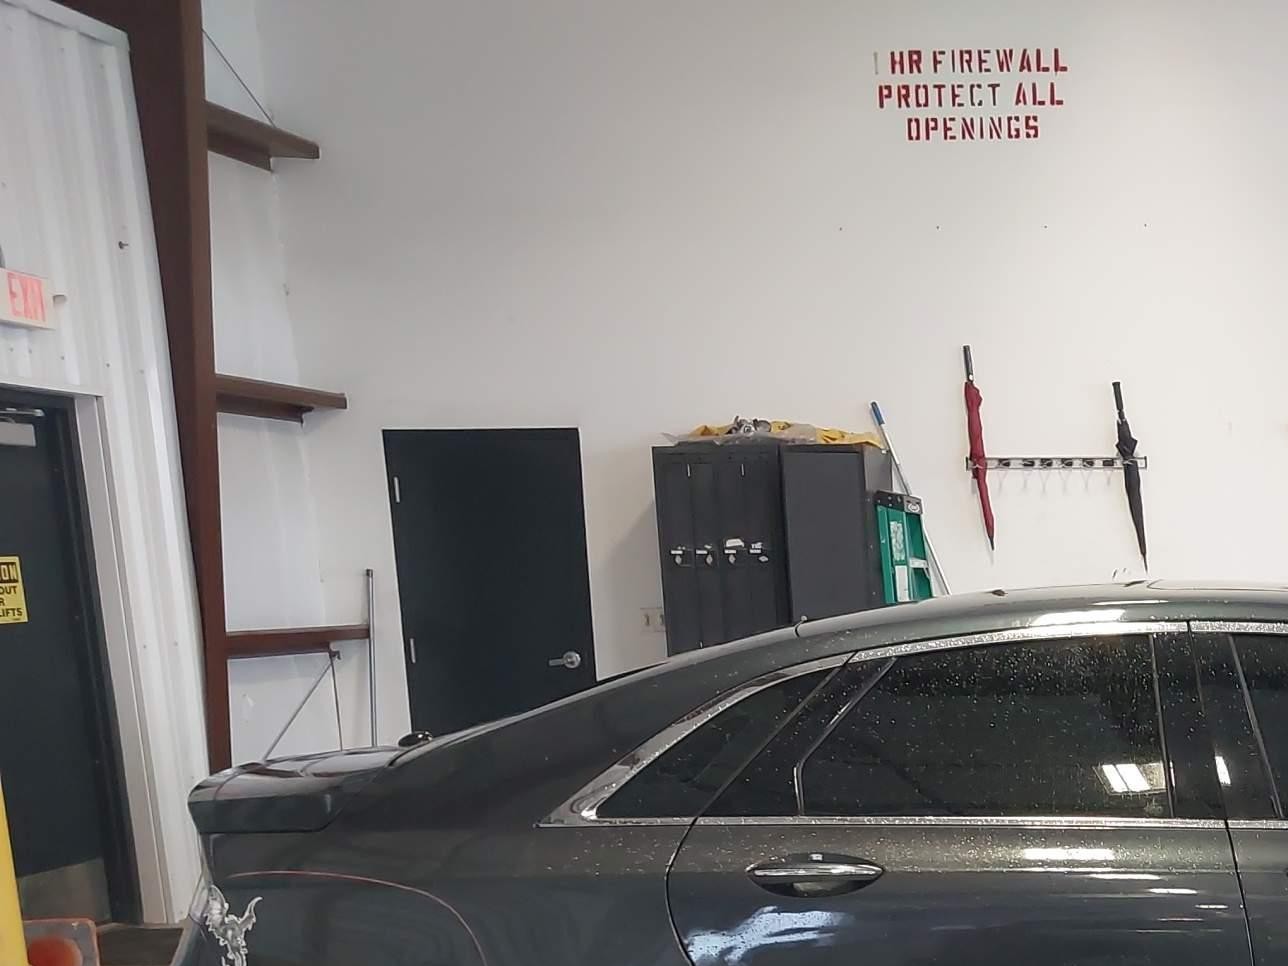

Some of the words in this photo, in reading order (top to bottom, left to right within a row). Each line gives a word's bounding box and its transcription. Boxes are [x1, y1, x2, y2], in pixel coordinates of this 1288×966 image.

[889, 49, 923, 74] HR
[932, 47, 1068, 74] FIREWALL
[877, 82, 1001, 109] PROTECT
[1014, 81, 1064, 106] ALL
[906, 114, 1040, 141] OPENINGS
[0, 607, 23, 618] IFTS
